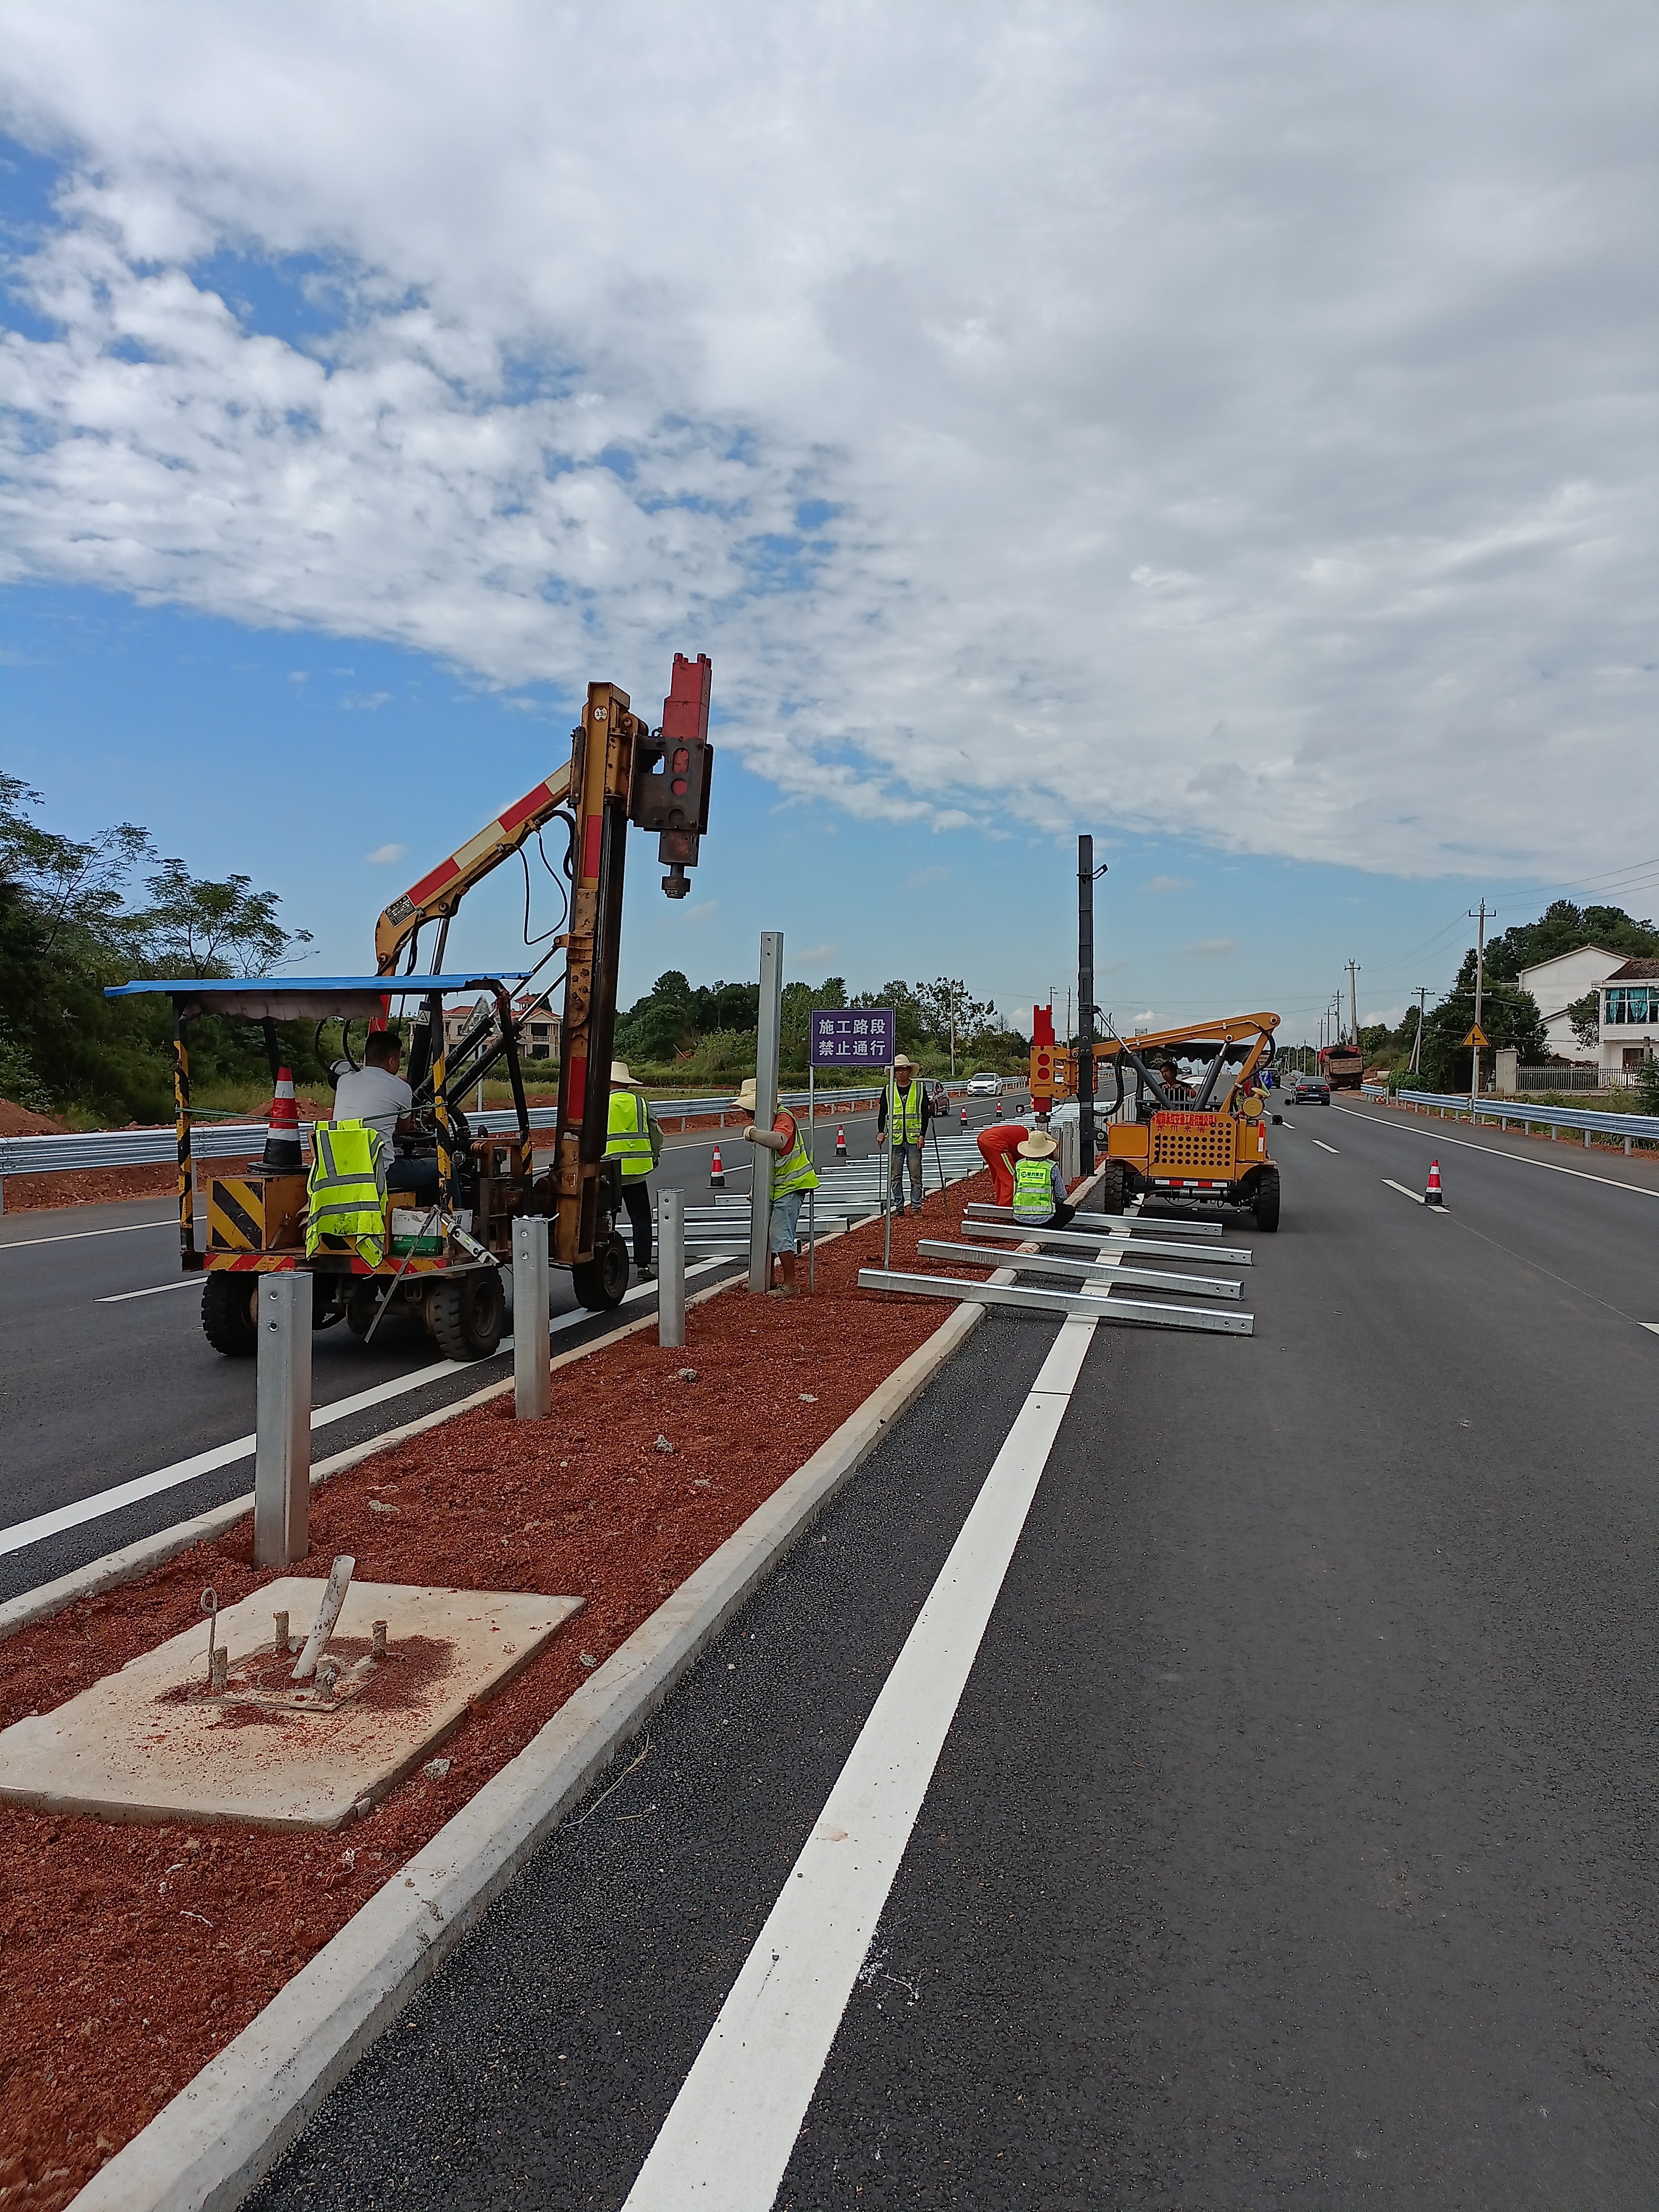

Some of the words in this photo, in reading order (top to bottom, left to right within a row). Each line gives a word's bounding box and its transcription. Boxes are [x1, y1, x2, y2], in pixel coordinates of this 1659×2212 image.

[819, 1018, 885, 1035] 施工路段
[819, 1040, 885, 1056] 禁止通行
